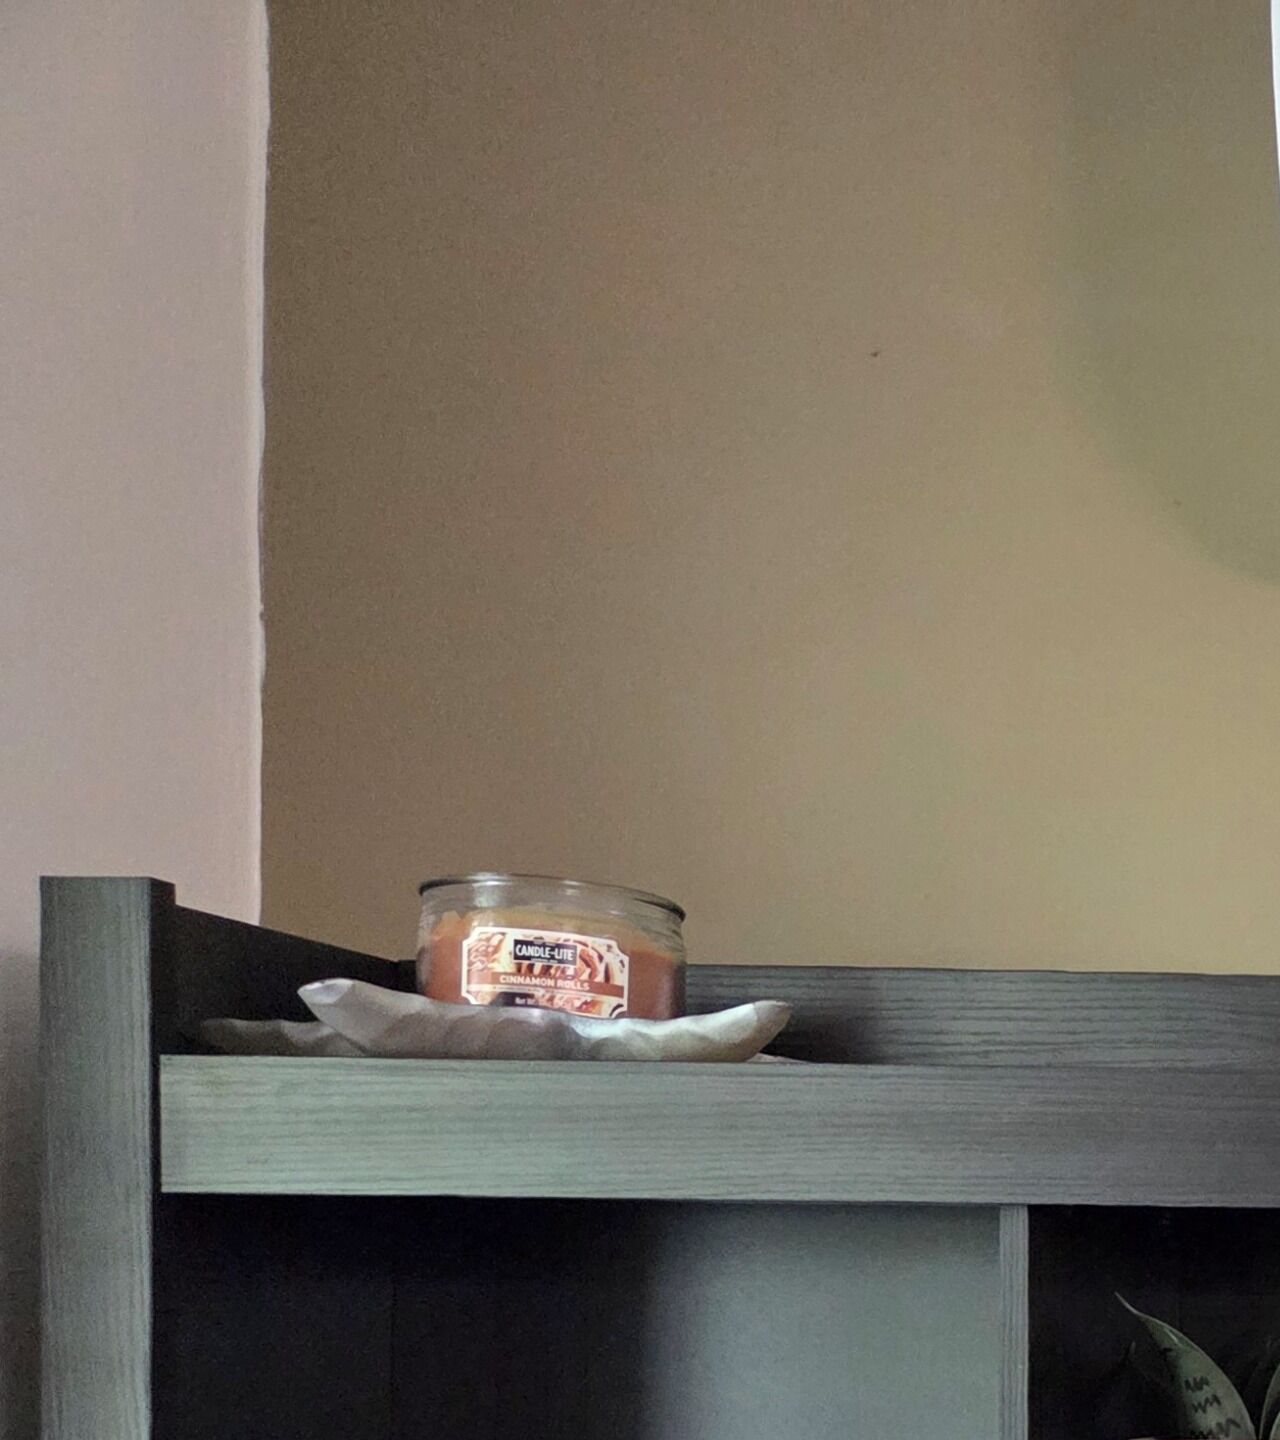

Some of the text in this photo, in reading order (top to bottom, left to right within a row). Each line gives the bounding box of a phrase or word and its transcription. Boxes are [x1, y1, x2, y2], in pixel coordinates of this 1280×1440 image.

[515, 944, 574, 961] CANDLE-LITE
[499, 974, 591, 992] CINNAMON ROLLS
